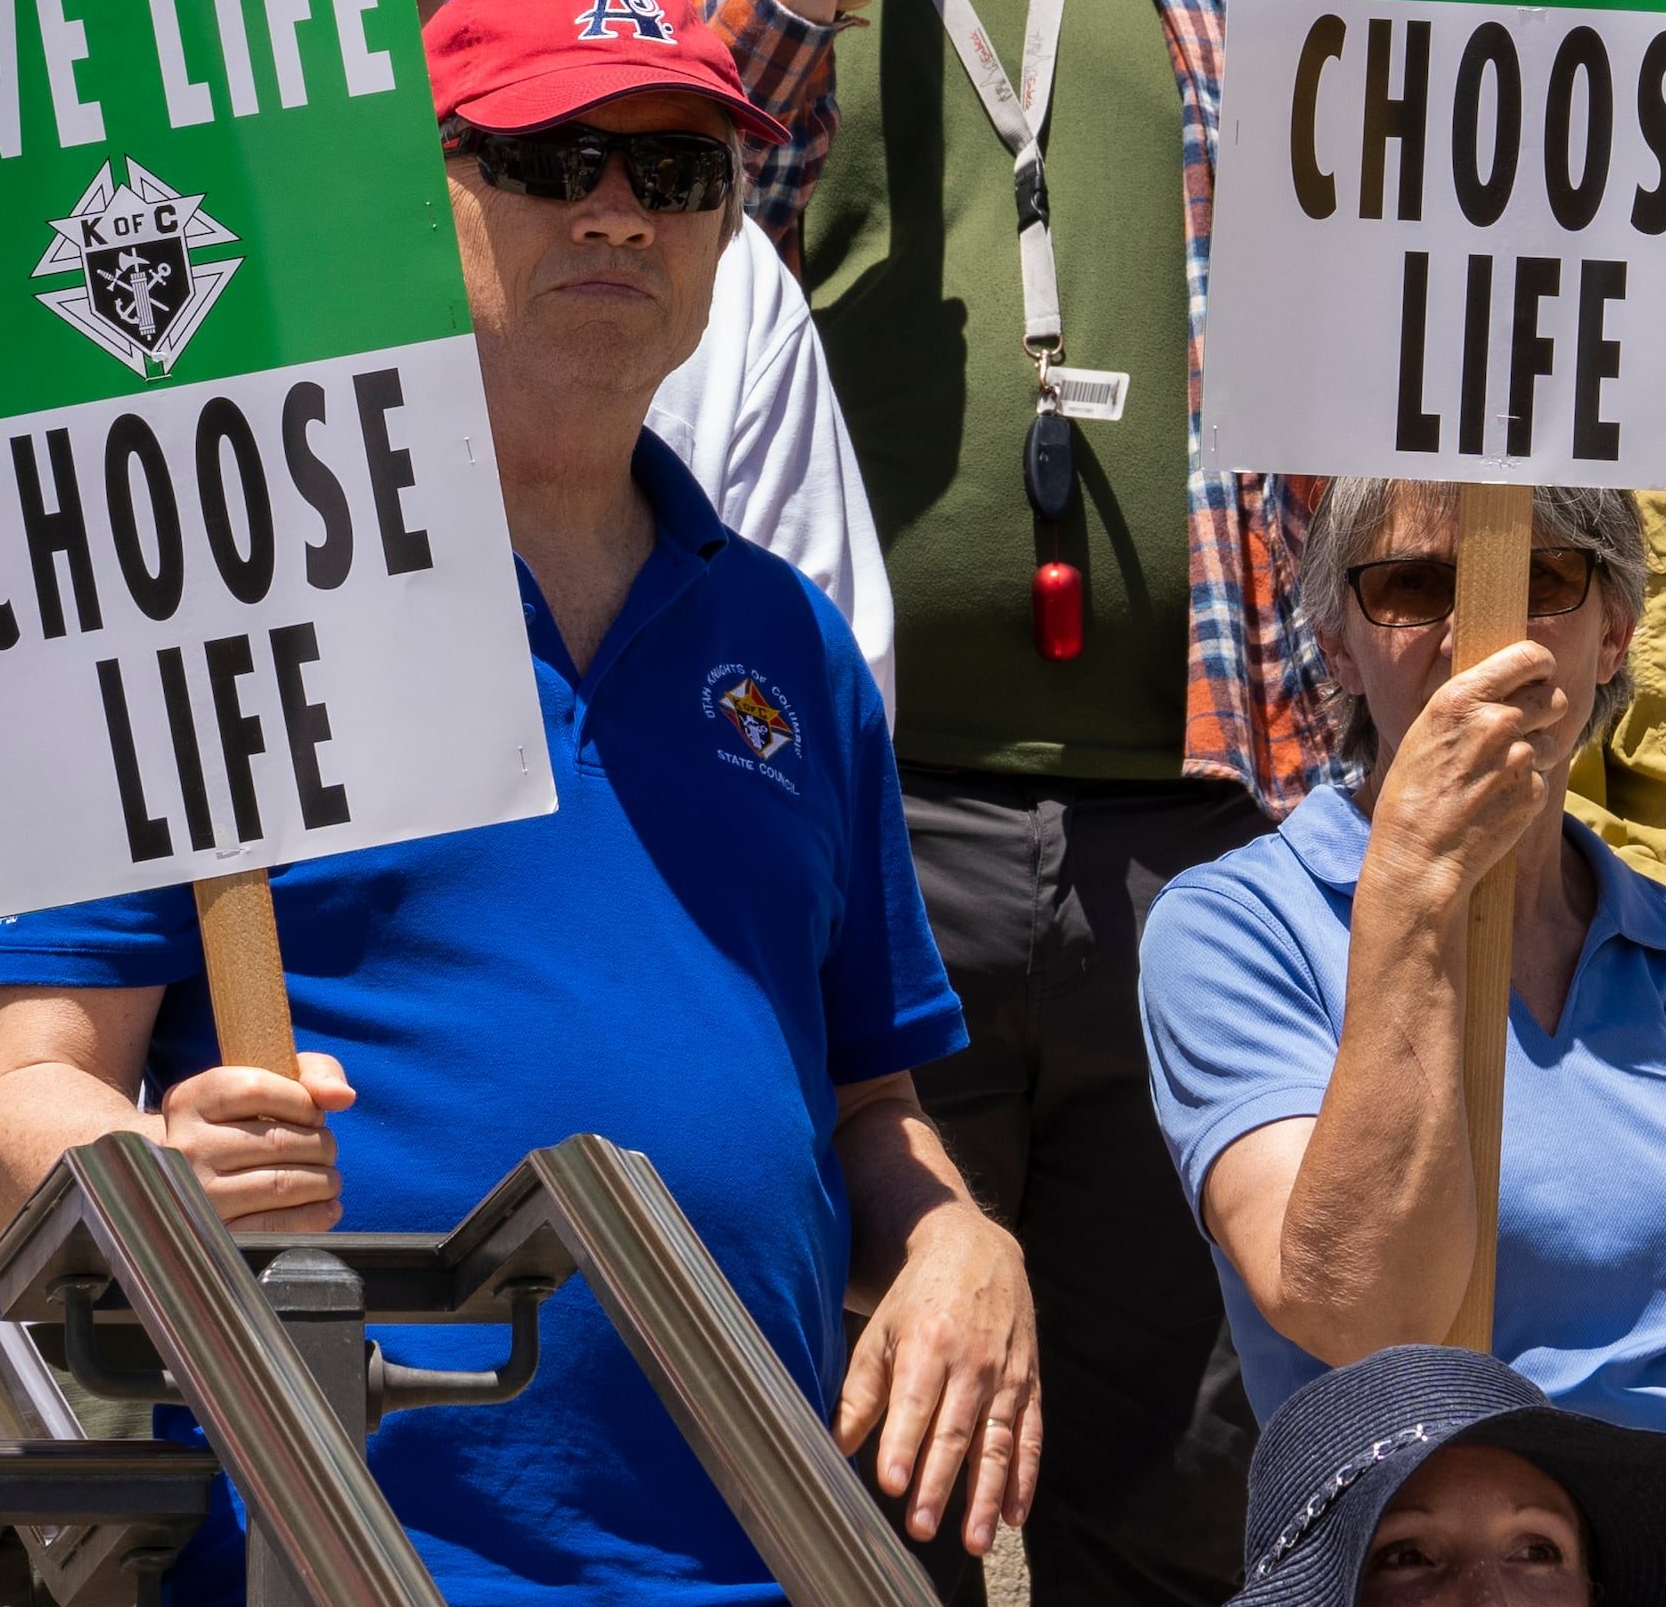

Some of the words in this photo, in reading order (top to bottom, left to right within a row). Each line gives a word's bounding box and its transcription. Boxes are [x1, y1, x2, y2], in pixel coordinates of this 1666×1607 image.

[81, 216, 107, 247] K
[113, 213, 144, 236] OF
[153, 206, 179, 235] C
[1395, 250, 1627, 461] LIFE
[707, 663, 746, 686] KNIGHTS
[750, 669, 768, 684] OF
[96, 621, 351, 862] LIFE
[716, 748, 756, 772] STATE
[758, 761, 801, 796] COUNCIL
